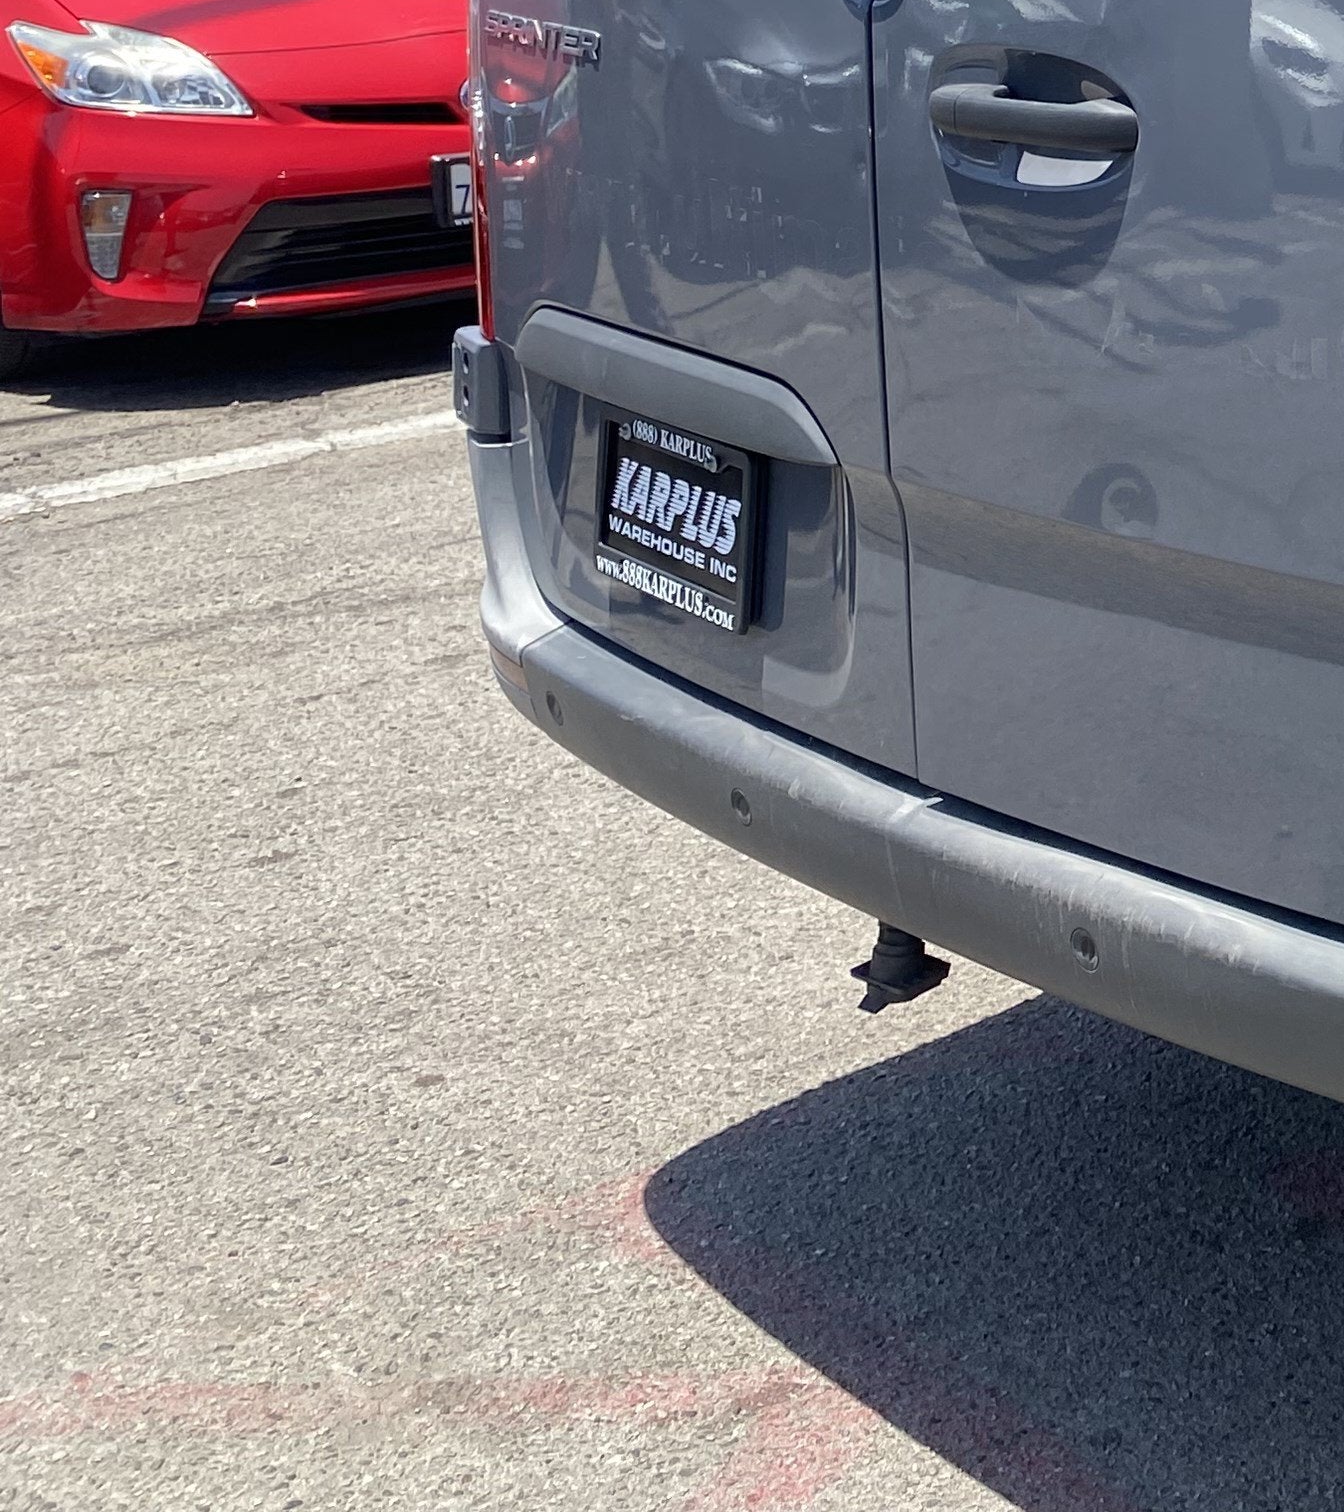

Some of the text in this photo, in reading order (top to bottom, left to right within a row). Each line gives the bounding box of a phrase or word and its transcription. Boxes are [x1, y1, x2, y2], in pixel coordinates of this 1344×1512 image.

[632, 419, 713, 464] (888) KARPLUS
[610, 457, 742, 555] KARPLUS
[608, 514, 738, 583] WAREHOUSE INC
